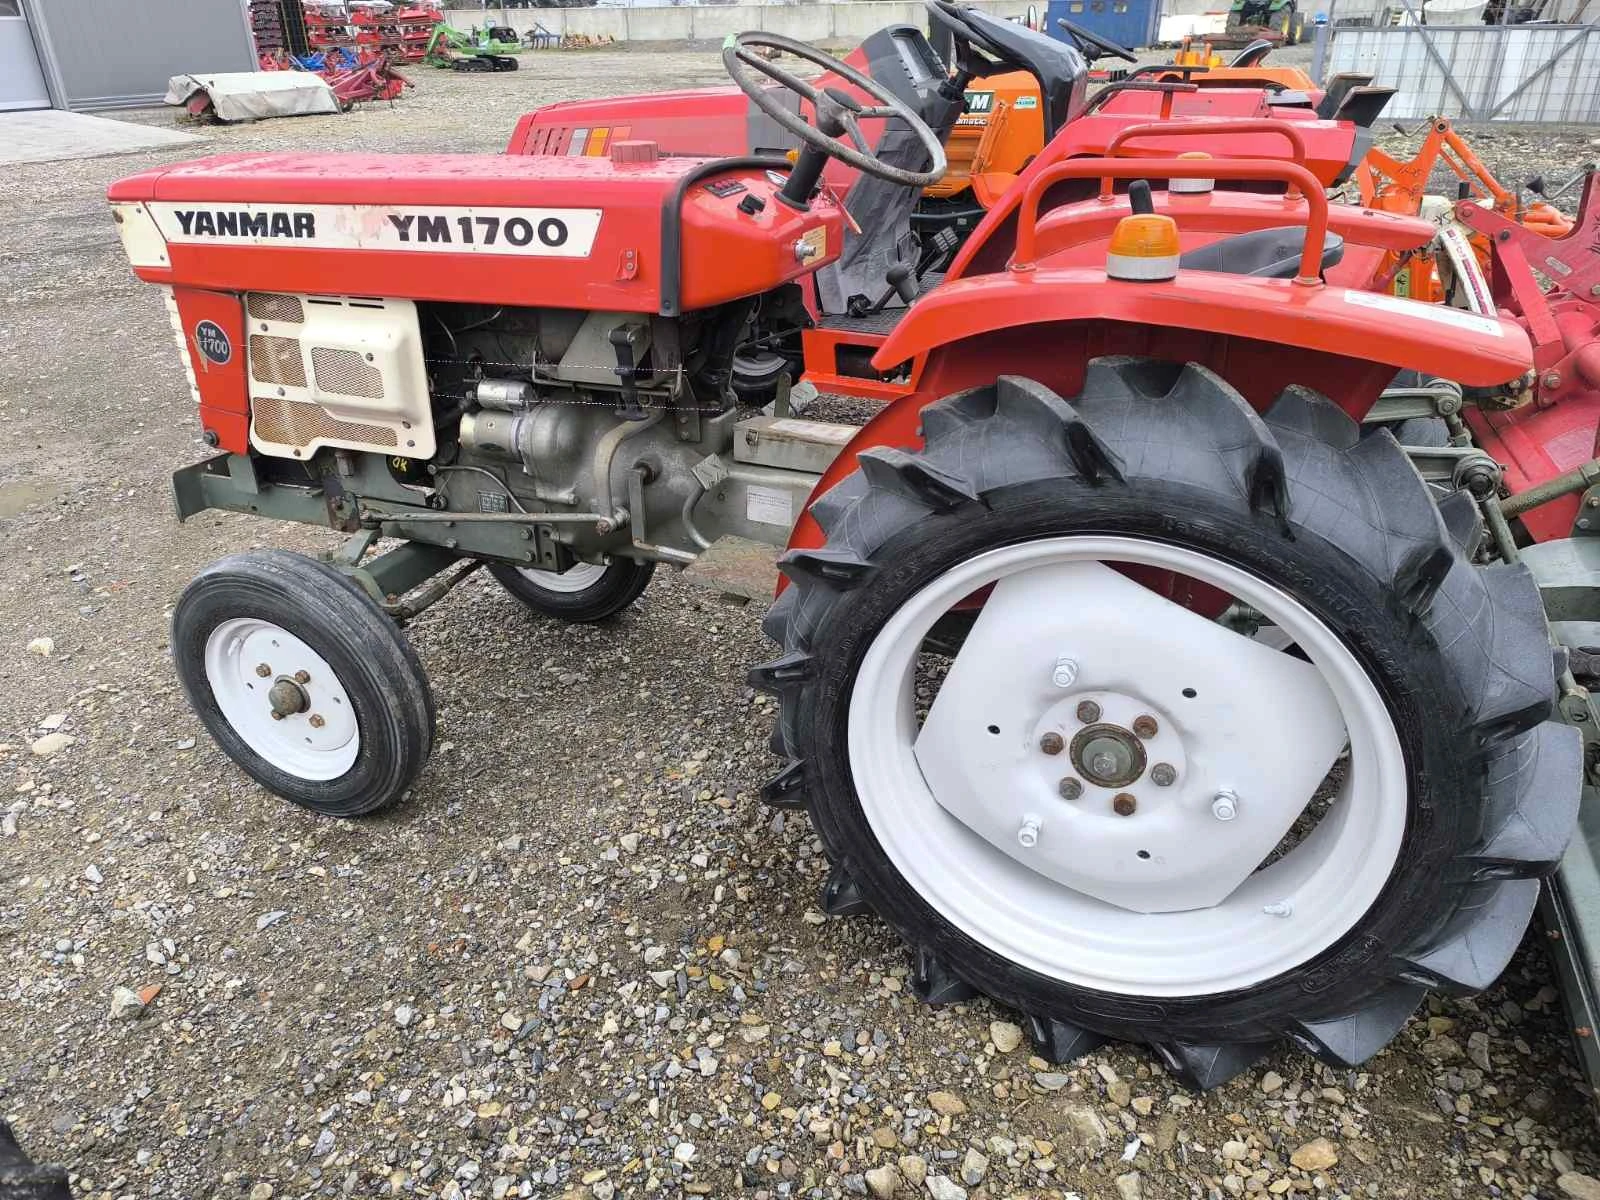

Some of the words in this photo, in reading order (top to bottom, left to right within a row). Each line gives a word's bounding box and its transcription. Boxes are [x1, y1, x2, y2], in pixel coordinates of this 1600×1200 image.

[174, 210, 316, 239] YANMAR
[200, 326, 216, 338] YM
[203, 337, 229, 355] 1700
[392, 456, 408, 472] OK
